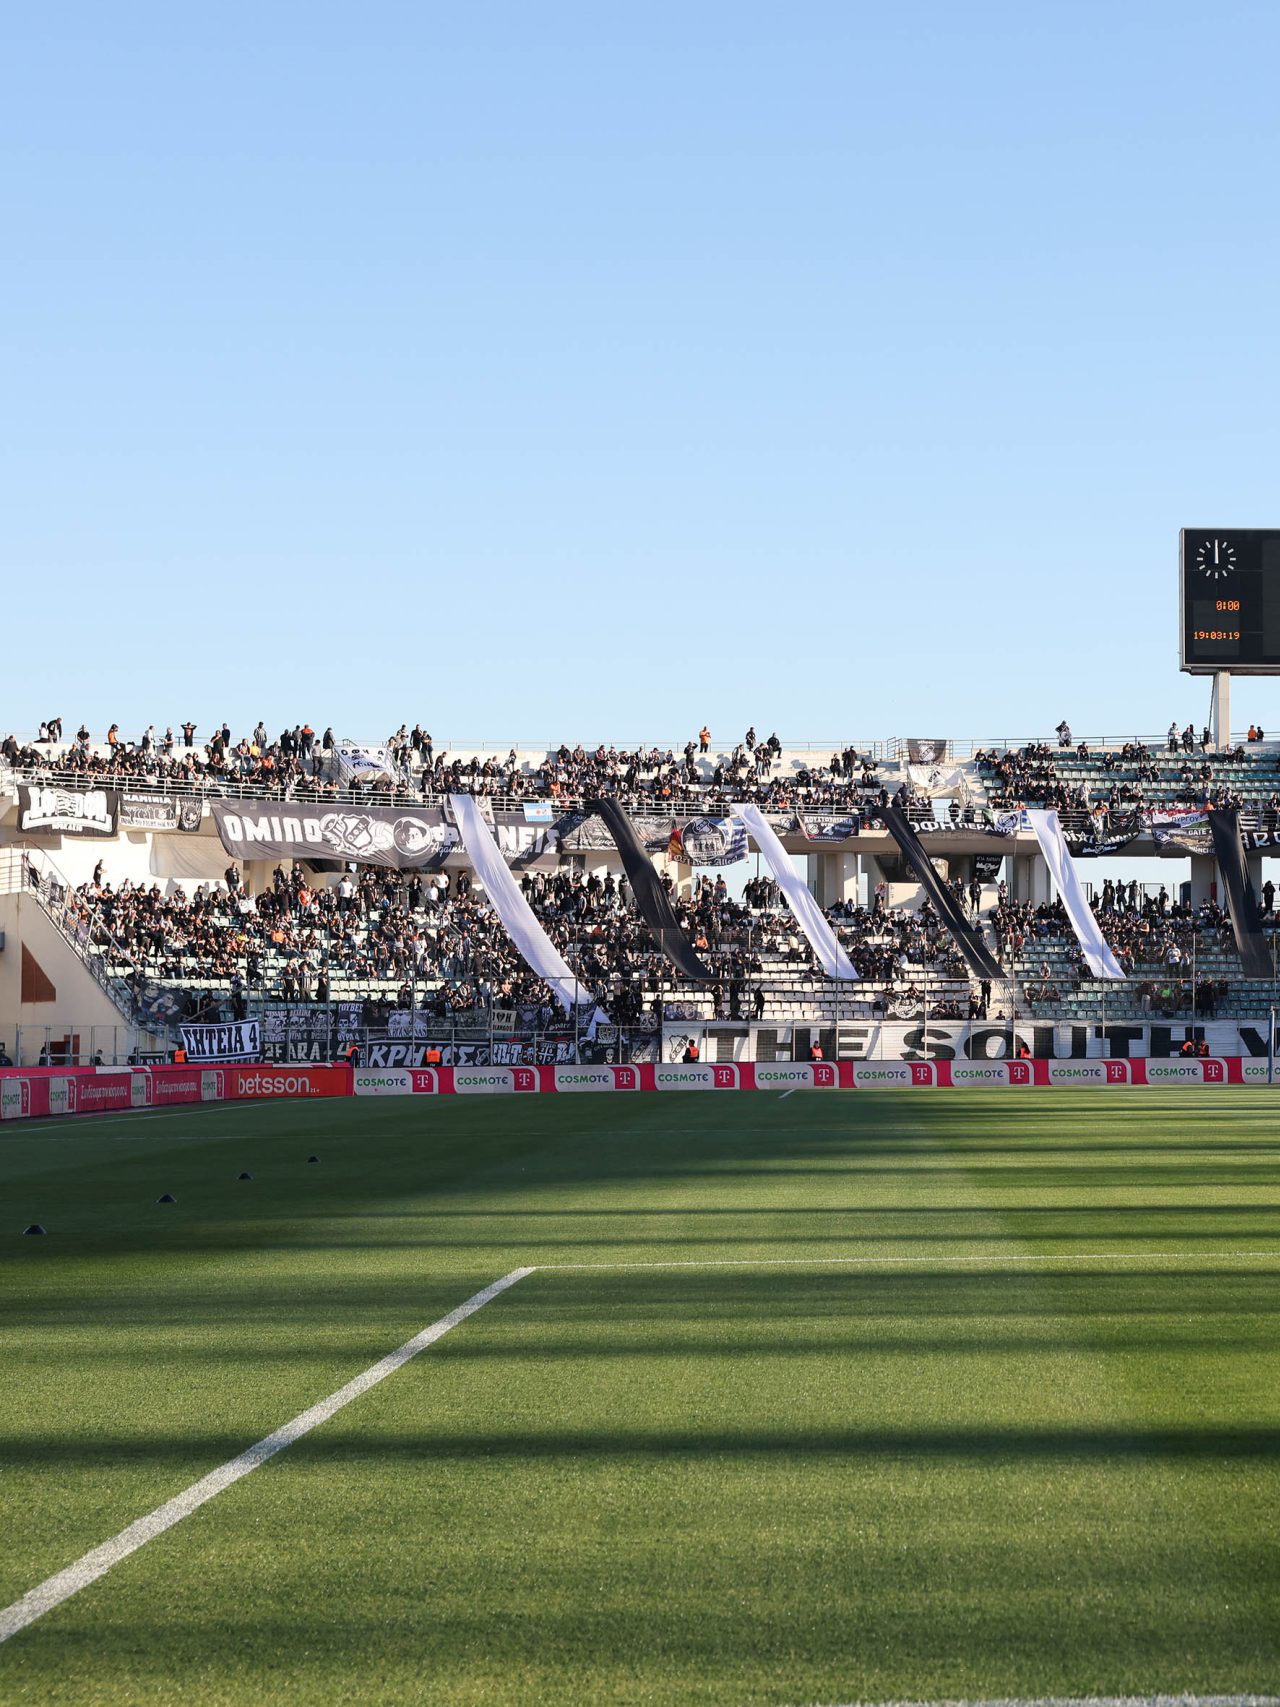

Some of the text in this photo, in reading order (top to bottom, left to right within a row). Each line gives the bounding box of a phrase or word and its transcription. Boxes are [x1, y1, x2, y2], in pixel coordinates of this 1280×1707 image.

[1216, 601, 1240, 611] 0:00
[1193, 631, 1240, 640] 19:03:19
[182, 1024, 258, 1057] ΣΗΤΕΙΑ 4
[702, 1028, 868, 1061] THE
[900, 1027, 1206, 1060] SOUTH
[658, 1072, 709, 1082] COSMOTE
[758, 1071, 808, 1081] COSMOTE
[856, 1070, 907, 1080] COSMOTE
[954, 1068, 1004, 1078] COSMOTE
[1052, 1068, 1101, 1077] COSMOTE
[1149, 1067, 1198, 1077] COSMOTE
[239, 1072, 310, 1094] betsson
[357, 1077, 407, 1087] COSMOTE
[457, 1076, 508, 1085] COSMOTE
[558, 1074, 609, 1084] COSMOTE
